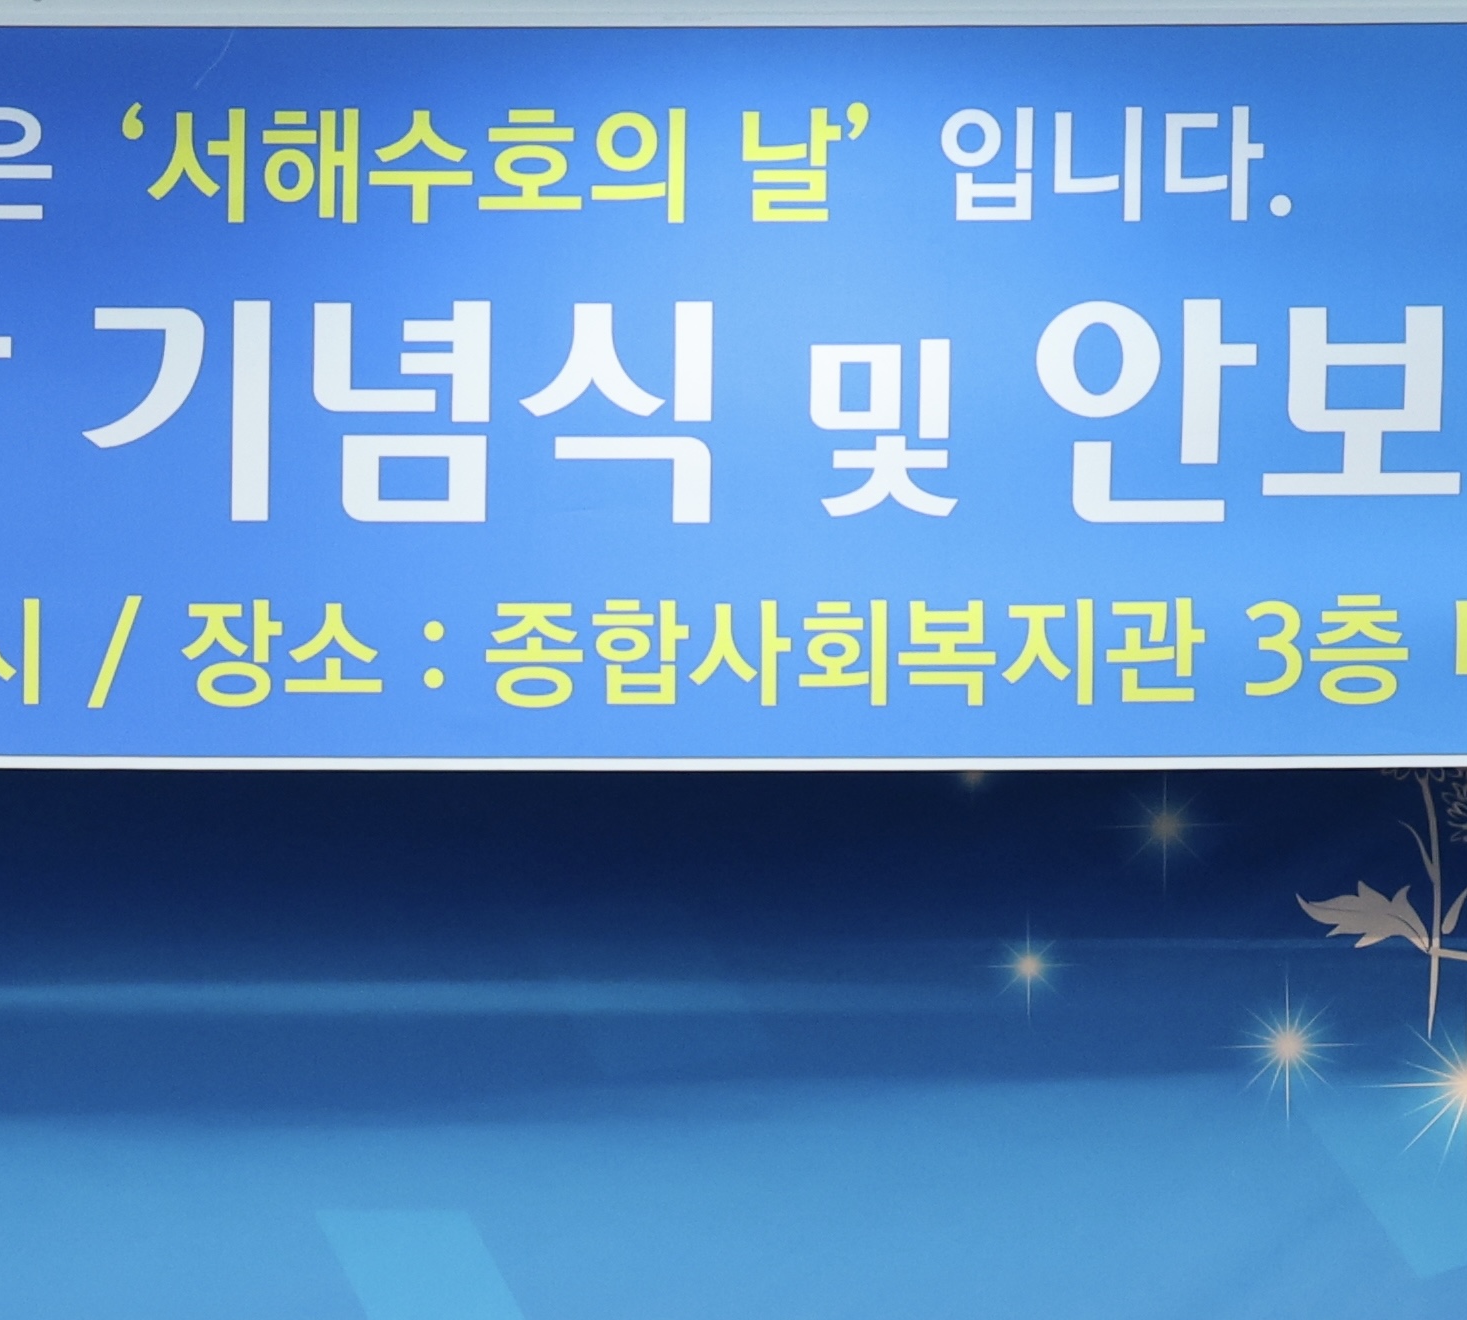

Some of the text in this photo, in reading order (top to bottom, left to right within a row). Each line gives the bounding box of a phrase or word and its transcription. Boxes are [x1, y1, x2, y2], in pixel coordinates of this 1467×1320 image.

[123, 108, 686, 224] ‘서해수호의
[742, 102, 869, 222] 날’
[941, 107, 1291, 222] 입니다.
[83, 300, 714, 524] 기념식
[809, 338, 958, 517] 및
[87, 595, 142, 708] /
[181, 599, 382, 707] 장소
[423, 620, 444, 689] :
[485, 597, 1205, 708] 종합사회복지관
[1245, 594, 1409, 705] 3층
